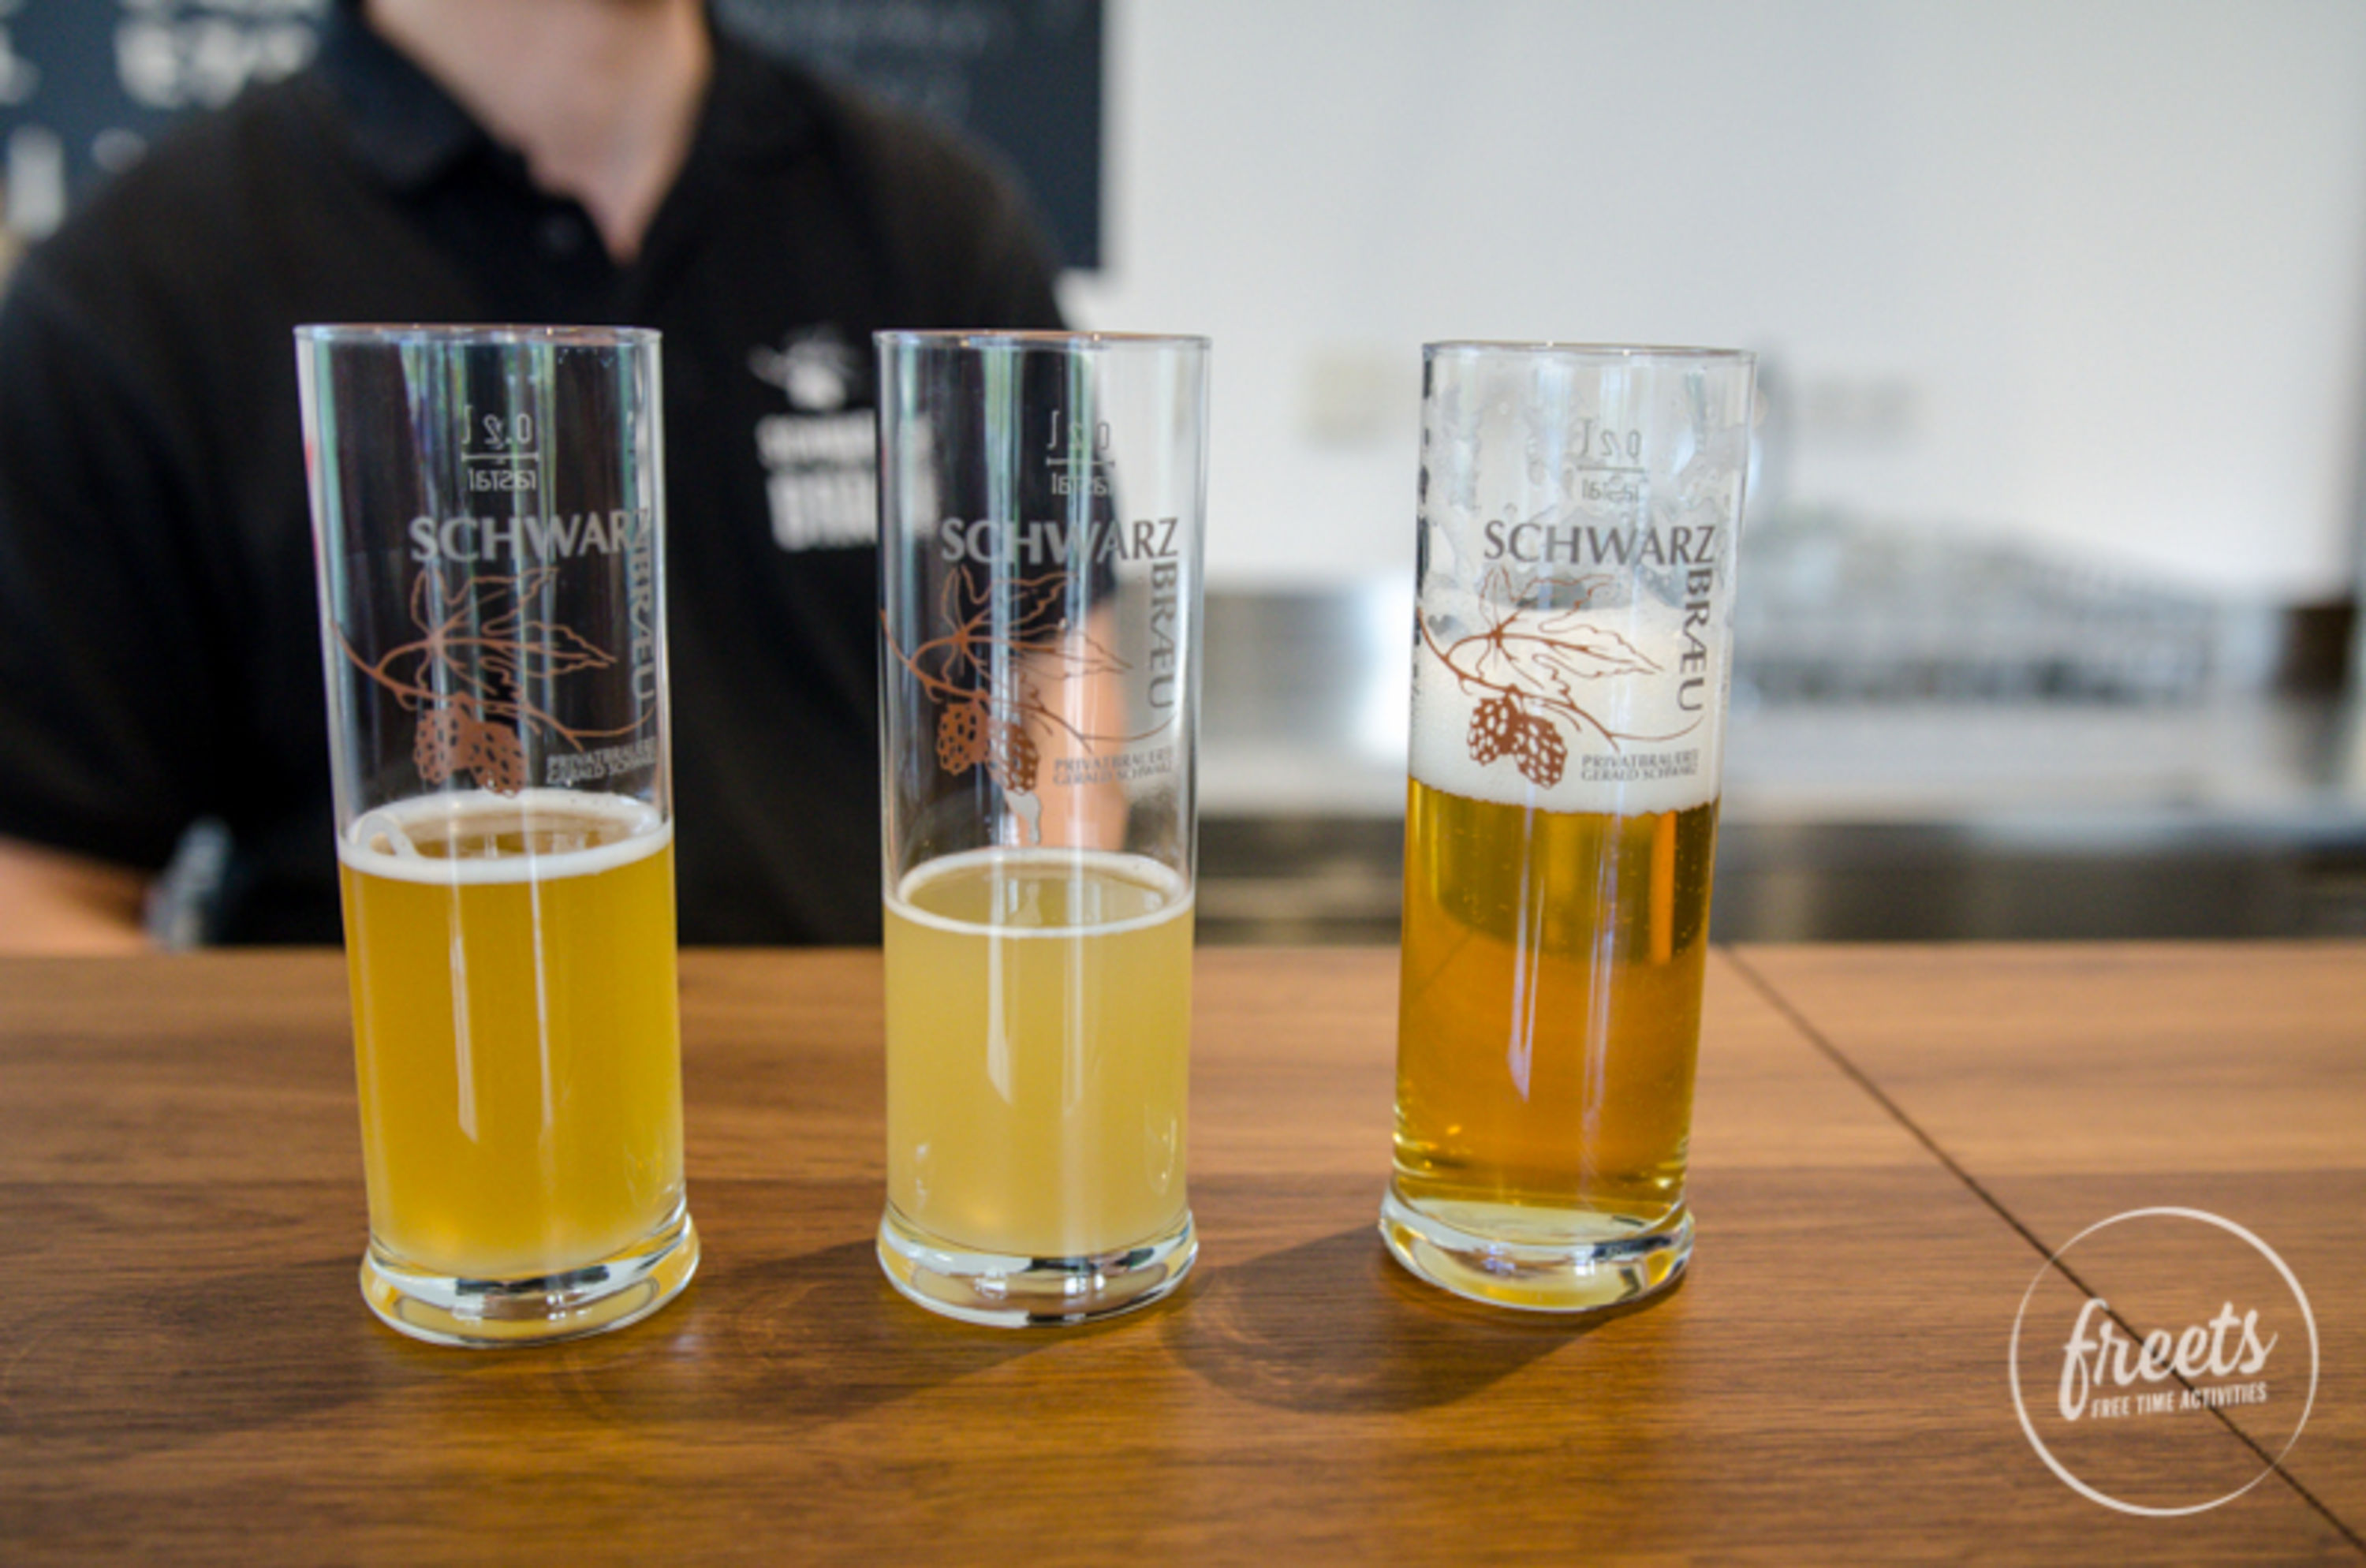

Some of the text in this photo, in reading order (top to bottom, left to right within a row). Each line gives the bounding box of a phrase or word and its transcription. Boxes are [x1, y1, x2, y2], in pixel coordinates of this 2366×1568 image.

[409, 508, 651, 562] SCHWARZ
[939, 516, 1180, 564] SCHWARZ
[1483, 520, 1717, 565] SCHWARZ
